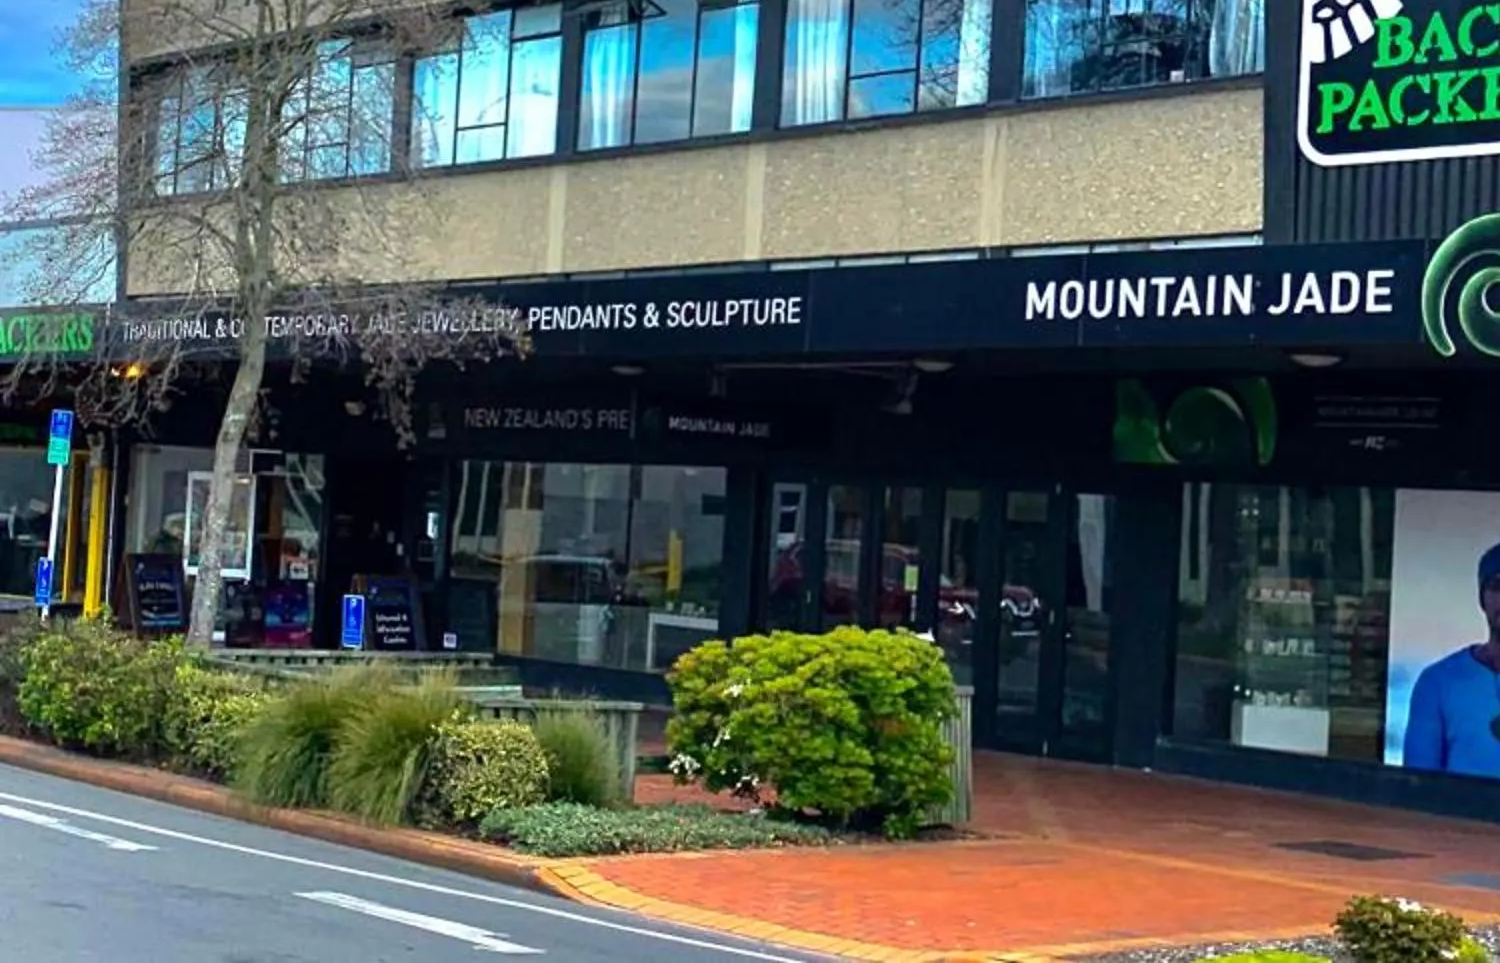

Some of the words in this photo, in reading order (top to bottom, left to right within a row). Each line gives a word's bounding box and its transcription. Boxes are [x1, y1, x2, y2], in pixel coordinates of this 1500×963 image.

[1025, 273, 1254, 320] MOUNTAIN
[1267, 269, 1395, 315] JADE
[215, 318, 227, 338] &
[528, 303, 637, 331] PENDANTS
[643, 302, 660, 328] &
[667, 297, 802, 327] SCULPTURE
[464, 407, 500, 429] NEW
[503, 408, 593, 430] ZEALAND'S
[667, 415, 736, 436] MOUNTAIN
